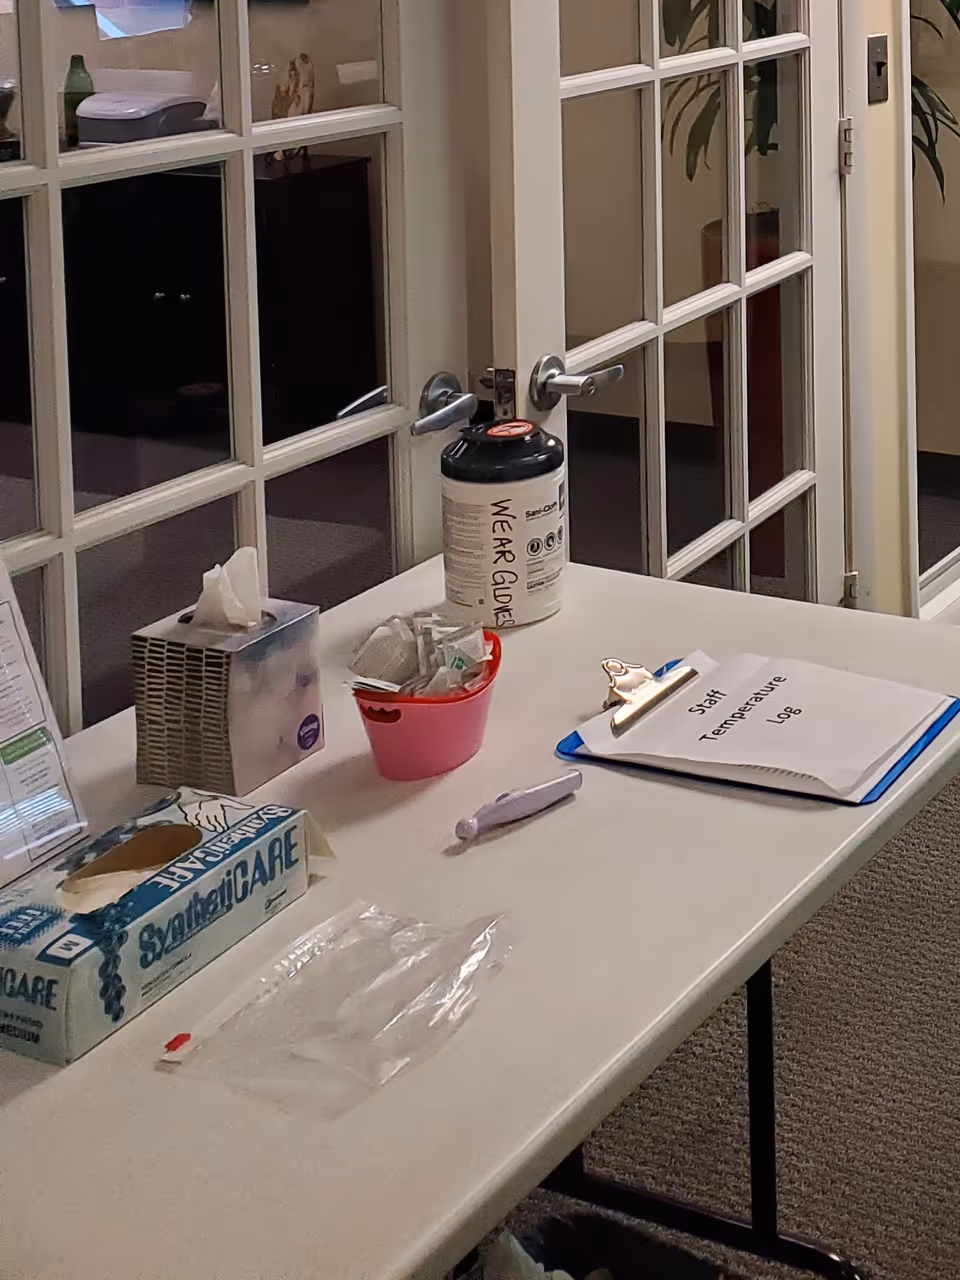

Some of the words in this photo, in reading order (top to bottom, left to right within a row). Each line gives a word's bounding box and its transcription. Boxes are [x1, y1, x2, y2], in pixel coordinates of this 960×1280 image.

[490, 498, 517, 565] WEAR
[688, 689, 727, 715] Staff
[698, 675, 787, 741] Temperature
[765, 706, 802, 725] Log
[146, 805, 293, 893] SynthetiCARE
[138, 824, 299, 969] SynthetiCARE
